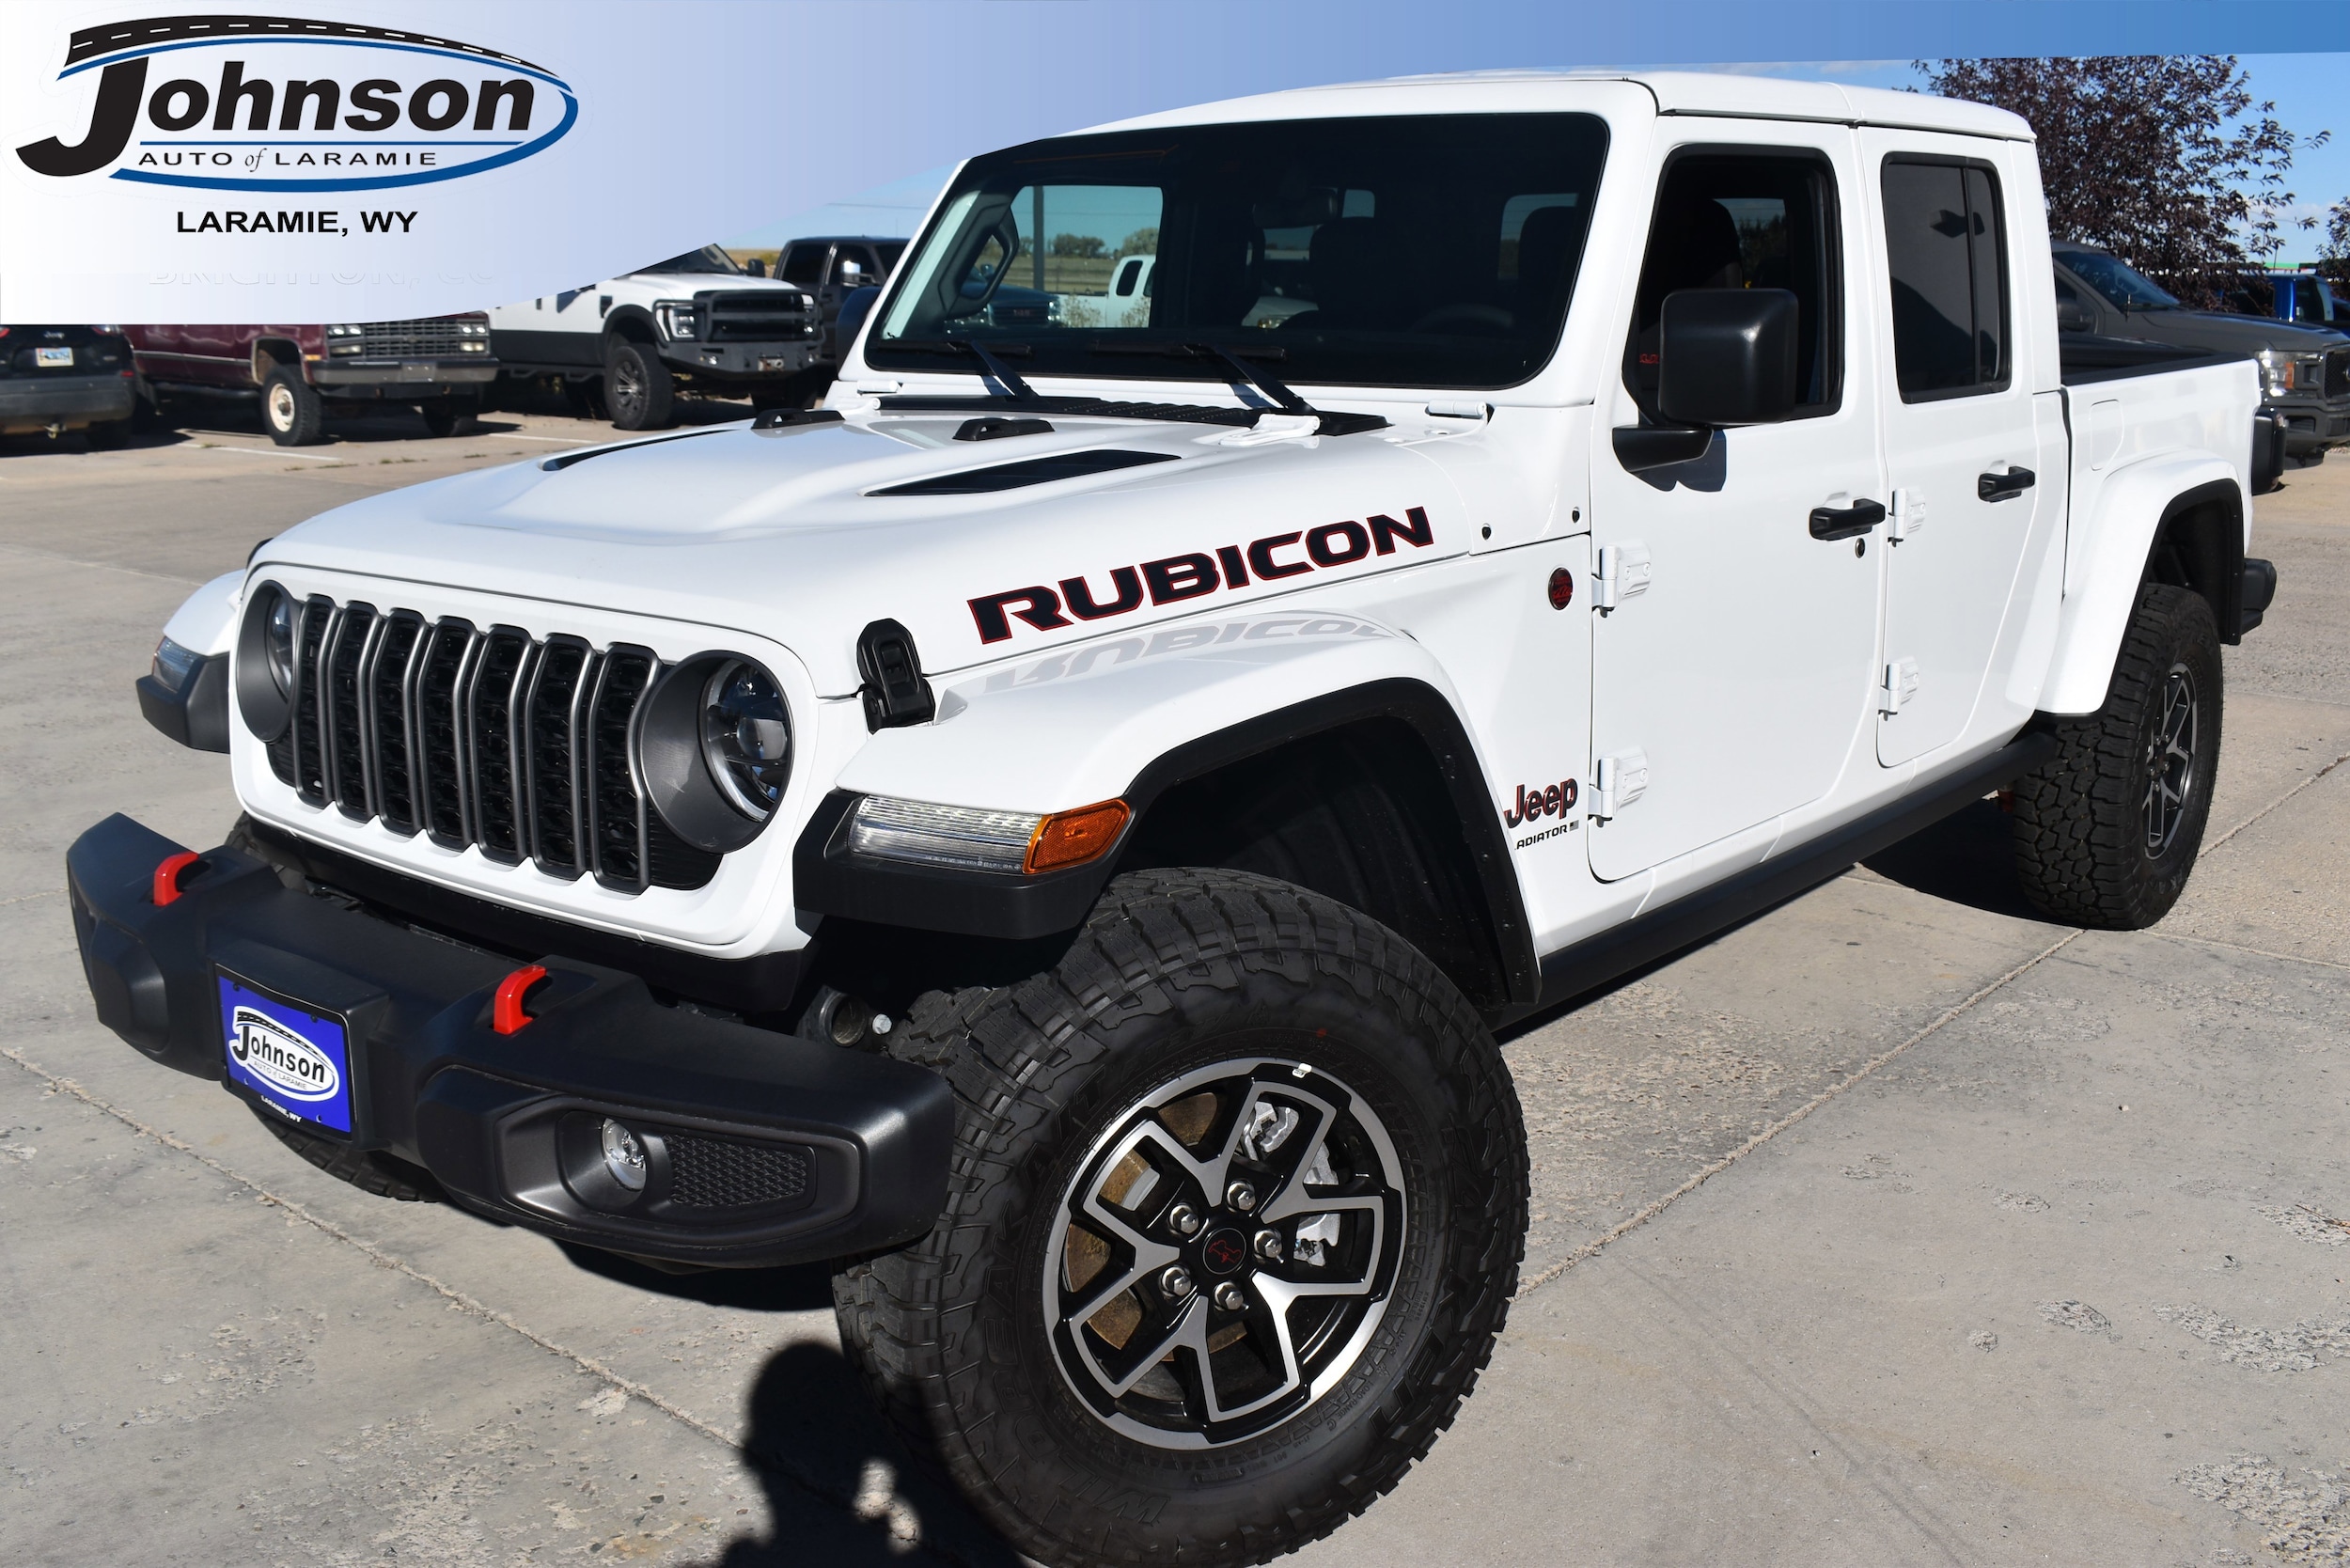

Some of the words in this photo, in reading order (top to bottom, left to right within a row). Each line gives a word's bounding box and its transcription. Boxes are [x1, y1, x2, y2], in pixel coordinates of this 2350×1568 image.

[966, 506, 1434, 645] RUBICON
[1504, 778, 1578, 829] Jeep
[1514, 824, 1567, 850] ADIATOR
[233, 1026, 325, 1083] Johnson
[254, 1061, 272, 1074] AUTO
[278, 1073, 307, 1090] LARAMIE
[289, 1112, 302, 1122] WY
